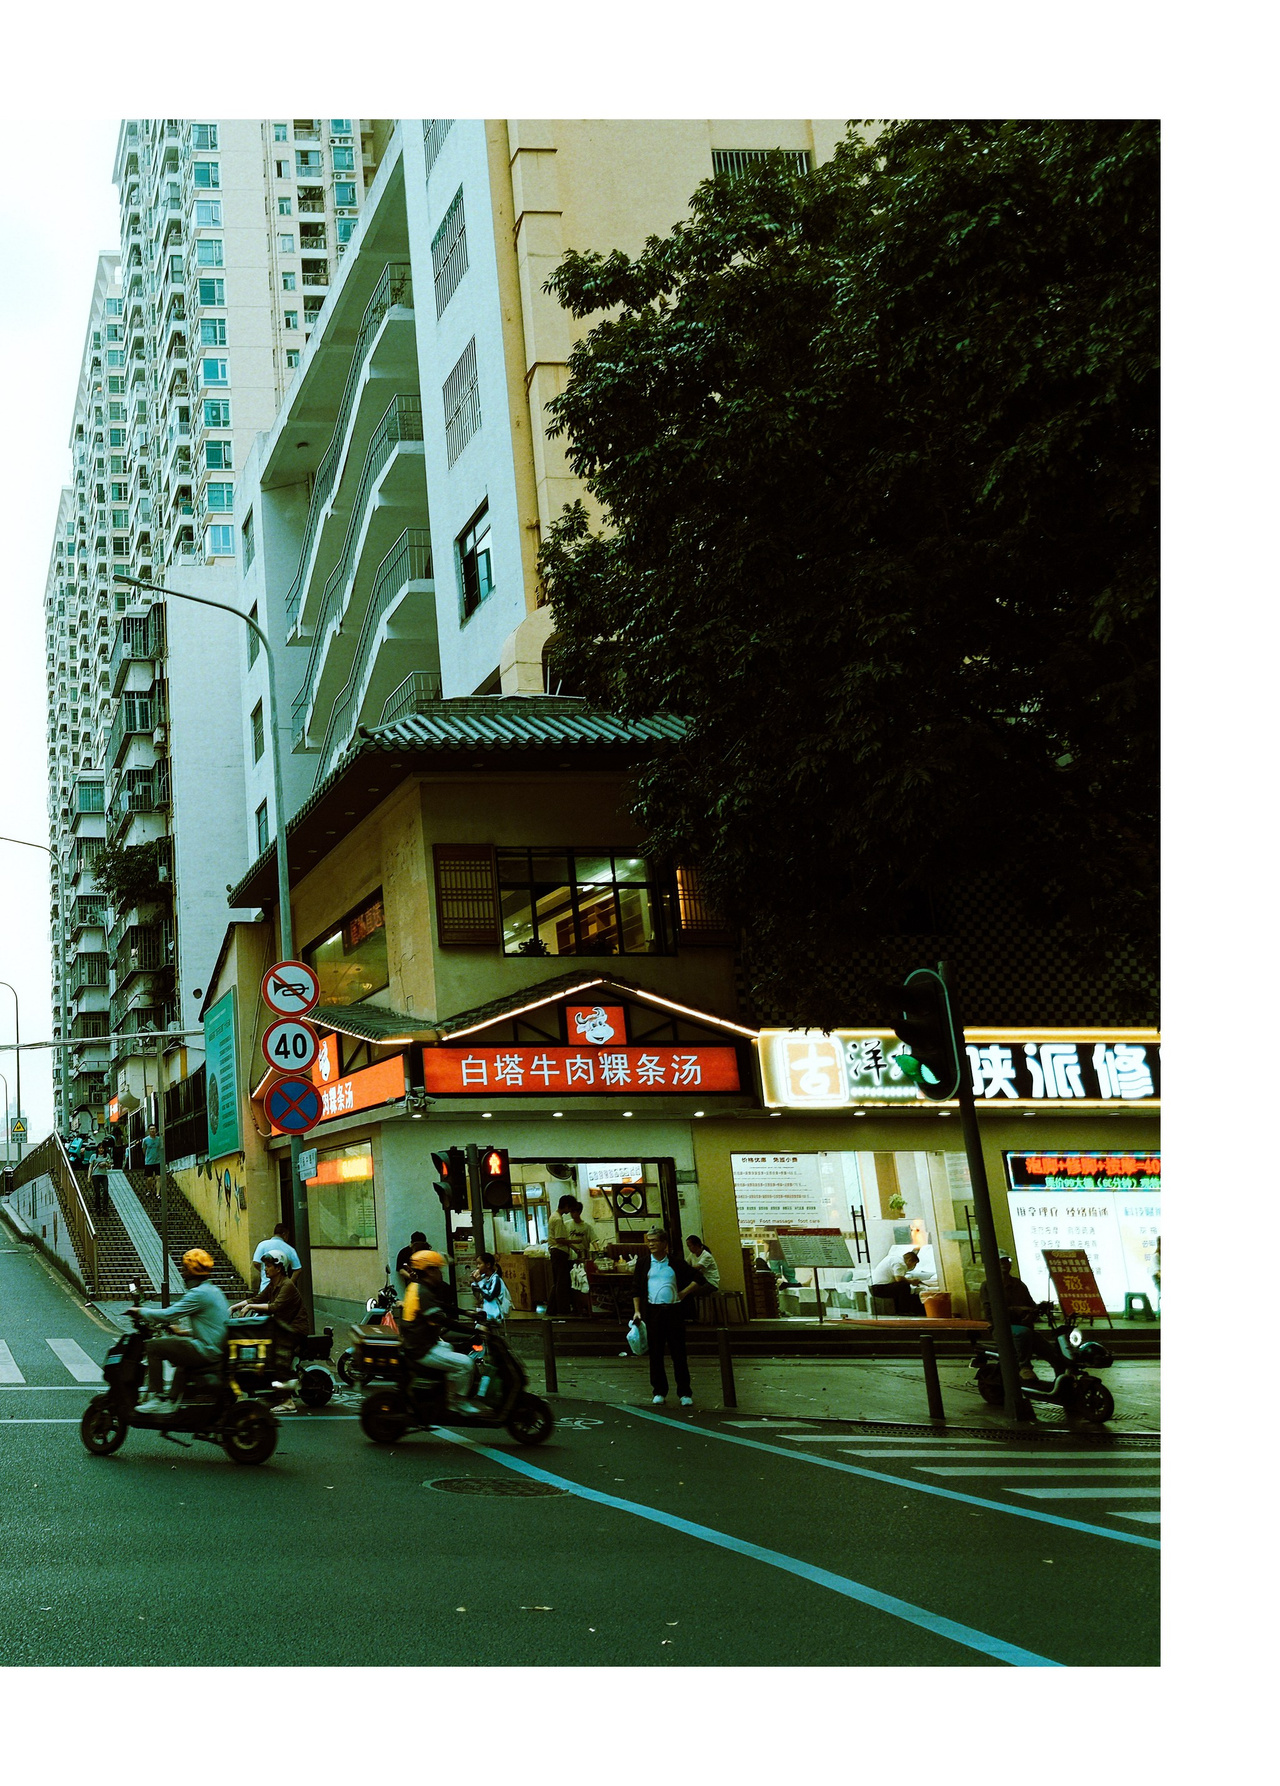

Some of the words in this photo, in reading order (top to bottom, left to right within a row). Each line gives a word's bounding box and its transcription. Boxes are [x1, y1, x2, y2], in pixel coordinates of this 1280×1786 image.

[275, 1033, 307, 1059] 40
[461, 1053, 702, 1087] 白塔牛肉粿条汤
[790, 1044, 833, 1089] 古
